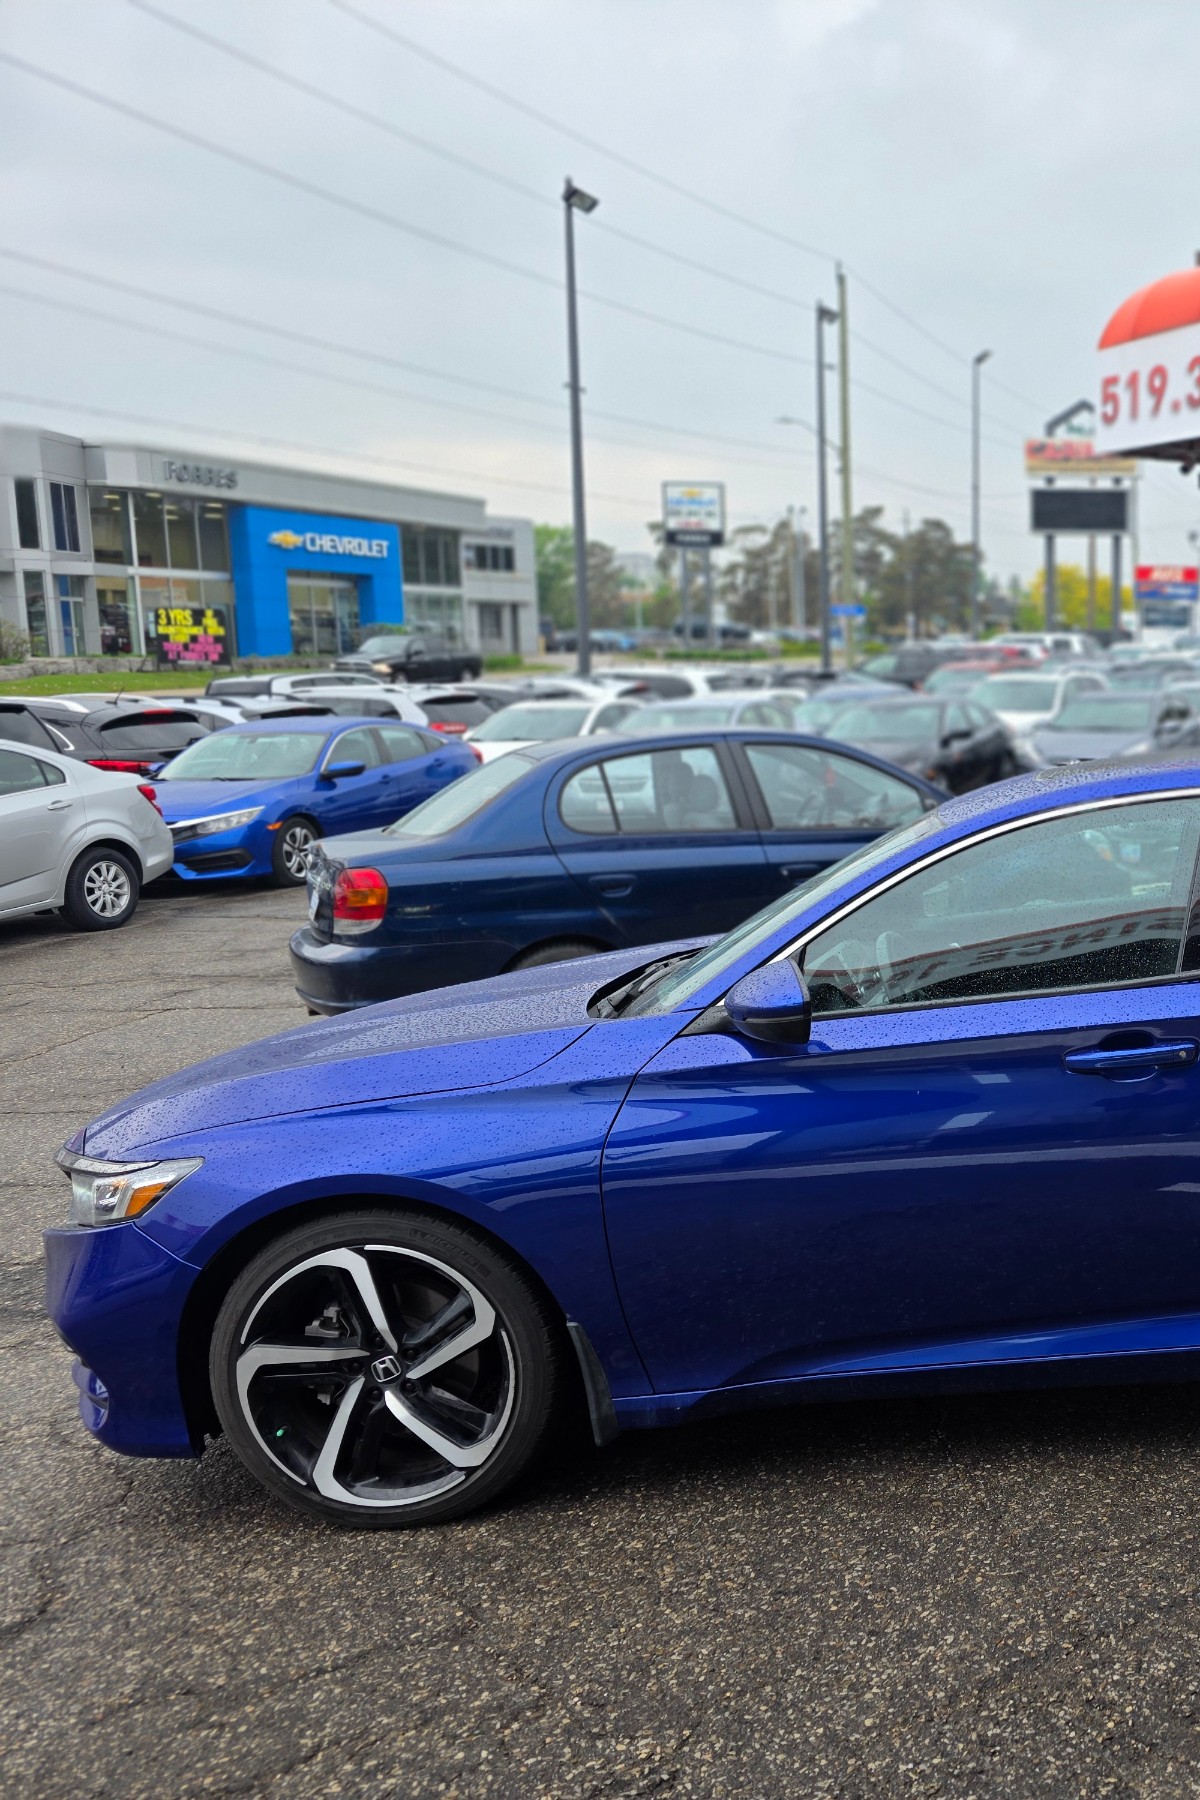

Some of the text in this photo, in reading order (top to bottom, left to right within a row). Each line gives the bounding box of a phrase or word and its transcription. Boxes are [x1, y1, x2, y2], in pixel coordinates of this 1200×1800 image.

[305, 532, 389, 559] CHEVROLET
[158, 608, 168, 626] 3
[168, 608, 193, 627] YRS
